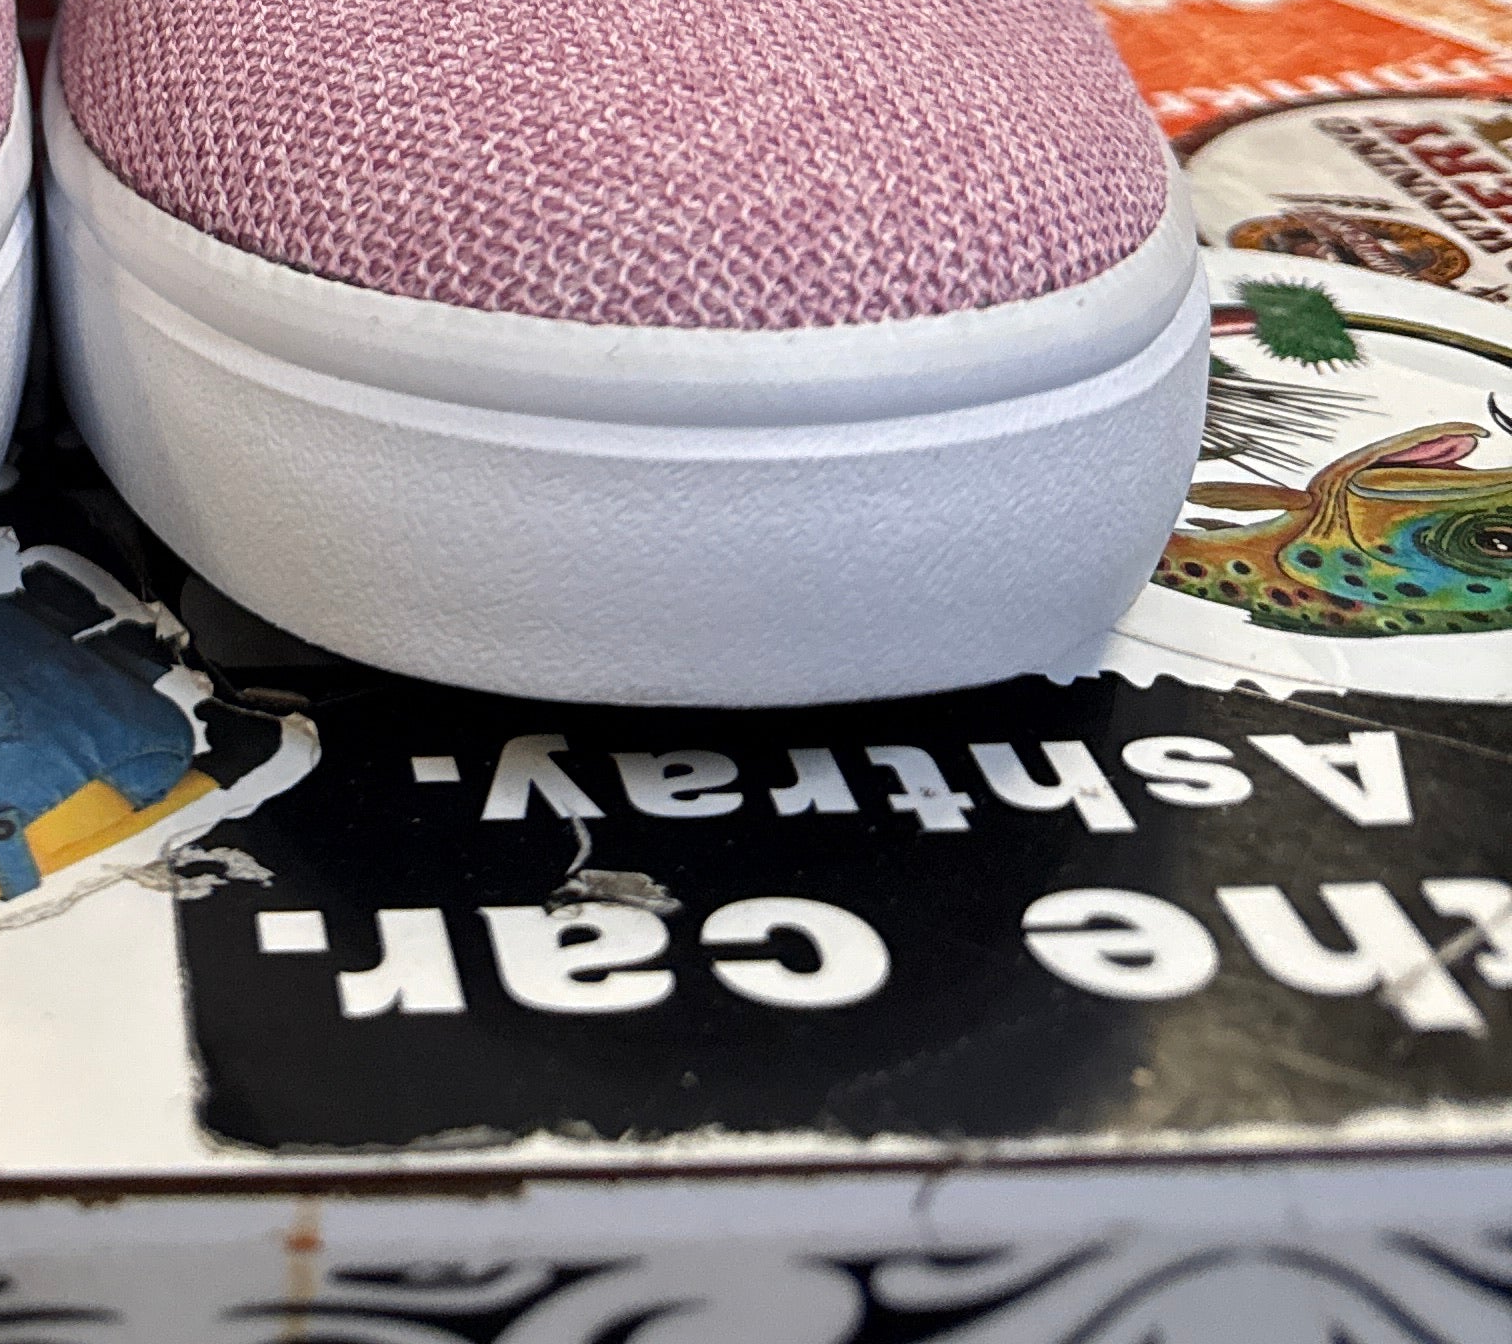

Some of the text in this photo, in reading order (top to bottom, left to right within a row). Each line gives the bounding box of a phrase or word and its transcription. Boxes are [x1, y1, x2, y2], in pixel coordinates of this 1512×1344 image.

[410, 729, 1414, 834] Ashtray.
[255, 876, 1512, 1040] the car.
